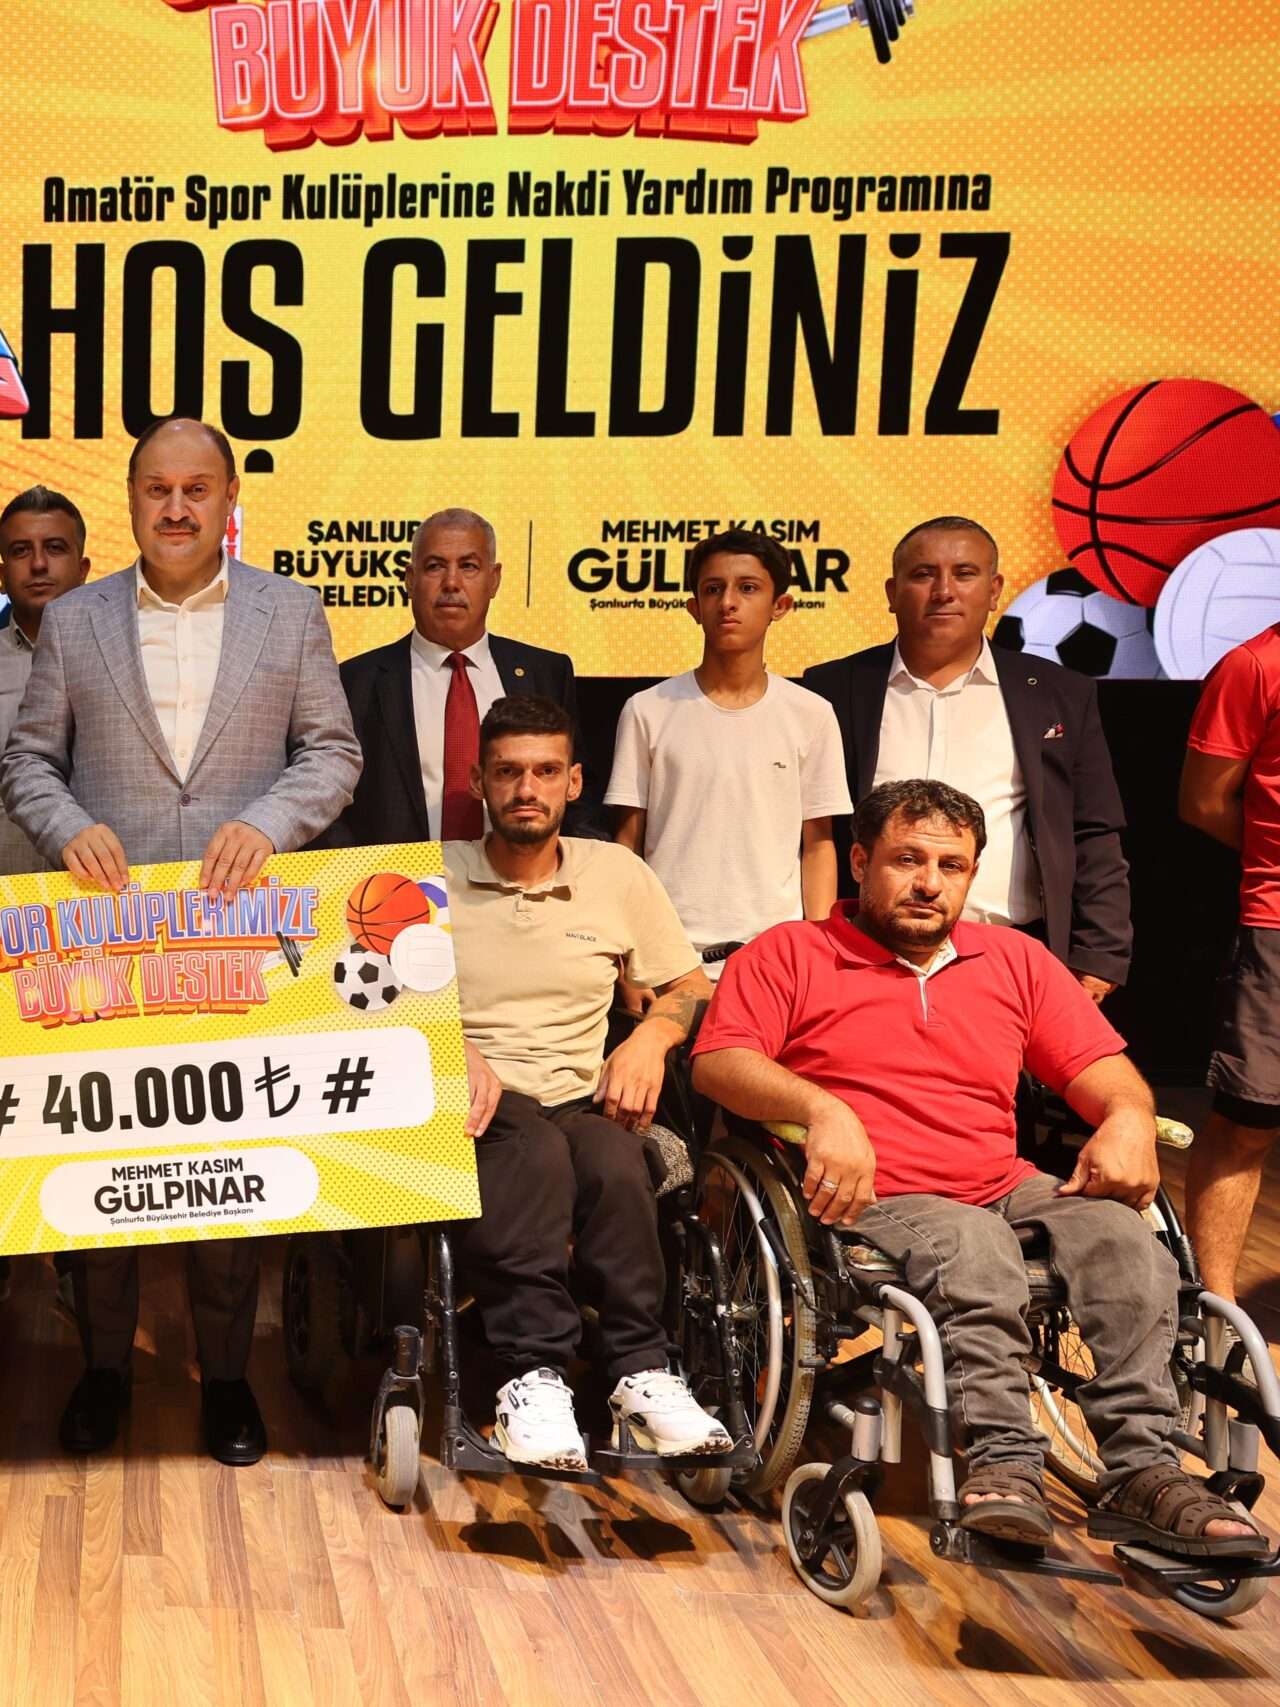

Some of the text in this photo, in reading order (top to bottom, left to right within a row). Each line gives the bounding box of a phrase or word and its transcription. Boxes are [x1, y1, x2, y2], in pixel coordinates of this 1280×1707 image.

[510, 0, 818, 124] DESTEK
[44, 166, 992, 229] Amatör Spor Kulüplerine Nakdi Yardım Programına
[20, 237, 305, 473] HOŞ
[307, 520, 423, 546] ŞANLIUR
[601, 519, 720, 543] MEHMET
[273, 550, 412, 581] BÜYÜKŞ
[567, 547, 851, 593] GÜLAR
[590, 598, 825, 610] Şanlıurfa Büyük şkanı
[12, 947, 269, 1019] BÜYÜK DESTEK
[42, 1060, 244, 1135] 40.000
[321, 1056, 375, 1115] #
[112, 1157, 244, 1181] MEHMET KASIM
[94, 1174, 266, 1214] GÜLPINAR
[110, 1207, 254, 1225] Şanlıurfa Büyükşehir Belediye Başkanı
